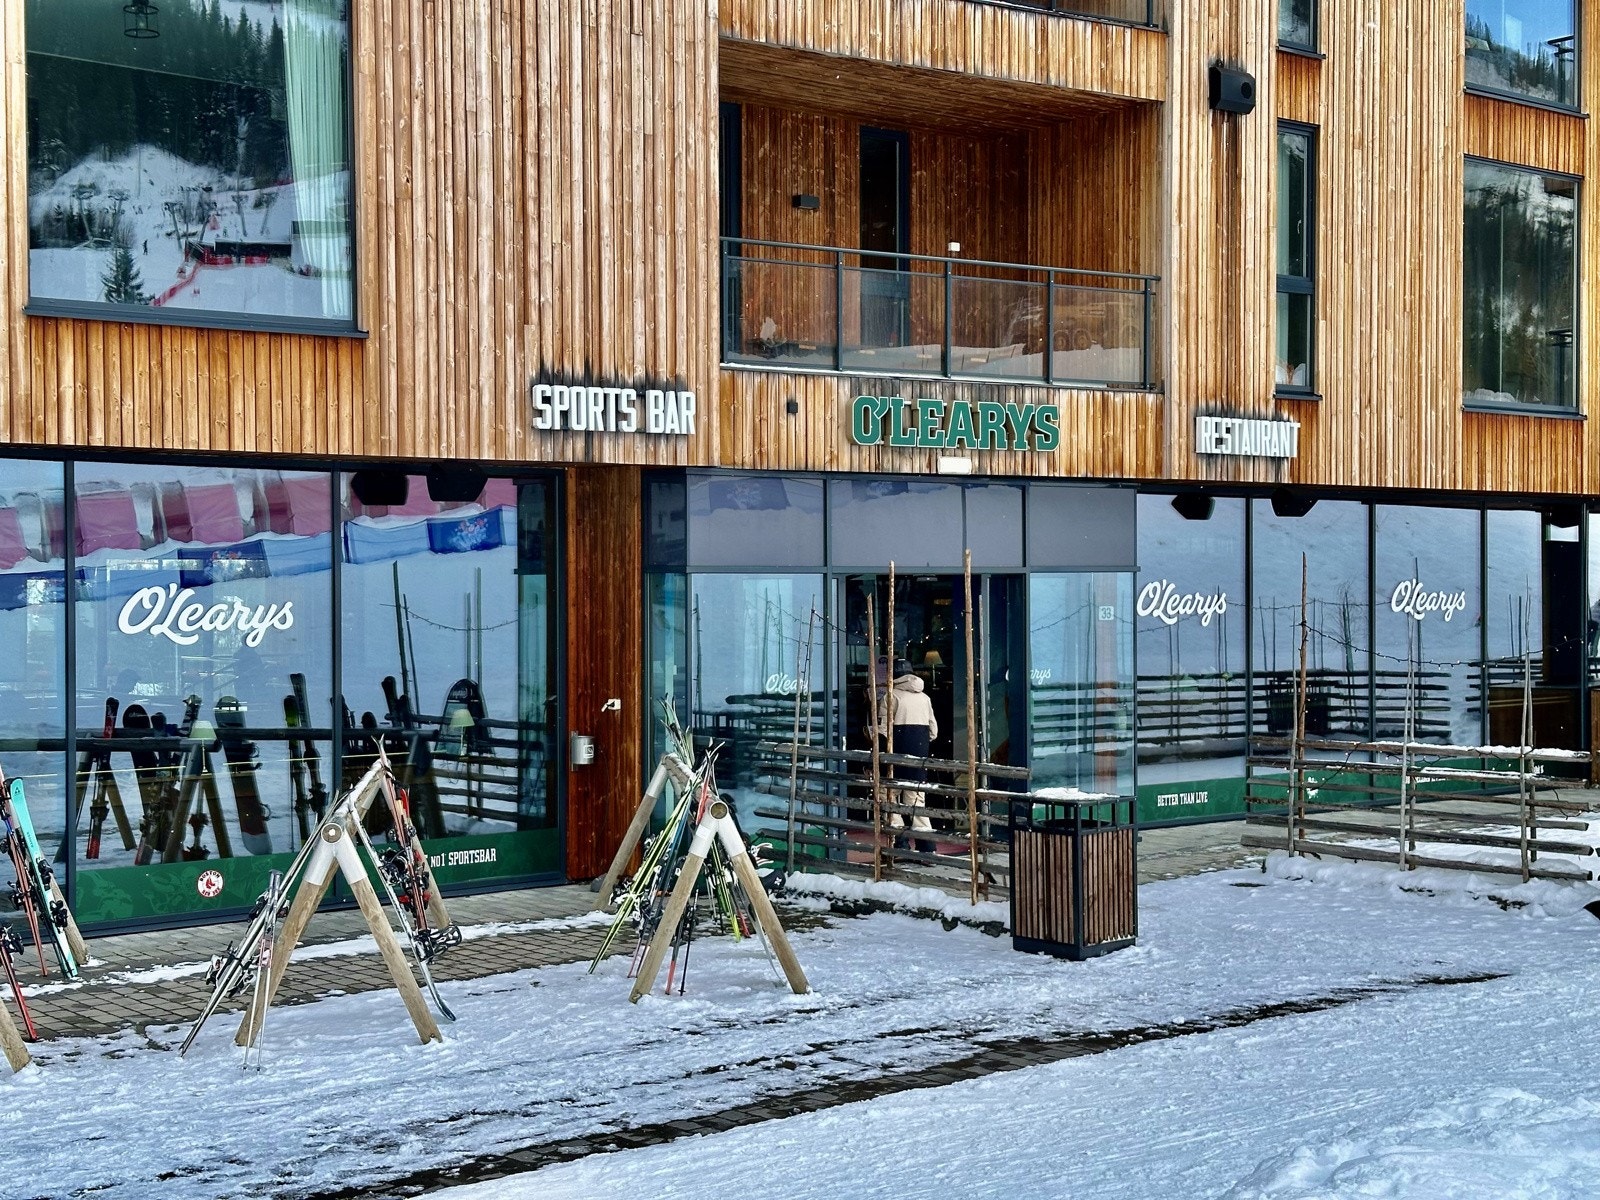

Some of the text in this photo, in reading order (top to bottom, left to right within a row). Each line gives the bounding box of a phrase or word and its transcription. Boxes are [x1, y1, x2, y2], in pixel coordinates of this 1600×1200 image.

[532, 384, 695, 434] SPORTS BAR
[852, 395, 1061, 451] O'LEARYS
[1196, 416, 1301, 457] RESTAURANT
[118, 583, 294, 647] O'Learys
[1101, 607, 1112, 619] 33
[1136, 579, 1226, 627] O'Learys
[1391, 578, 1466, 622] O'Learys
[766, 672, 809, 695] O'Leary
[1157, 791, 1208, 807] BETTER THAN LIVE
[449, 848, 497, 866] SPORTSBAR
